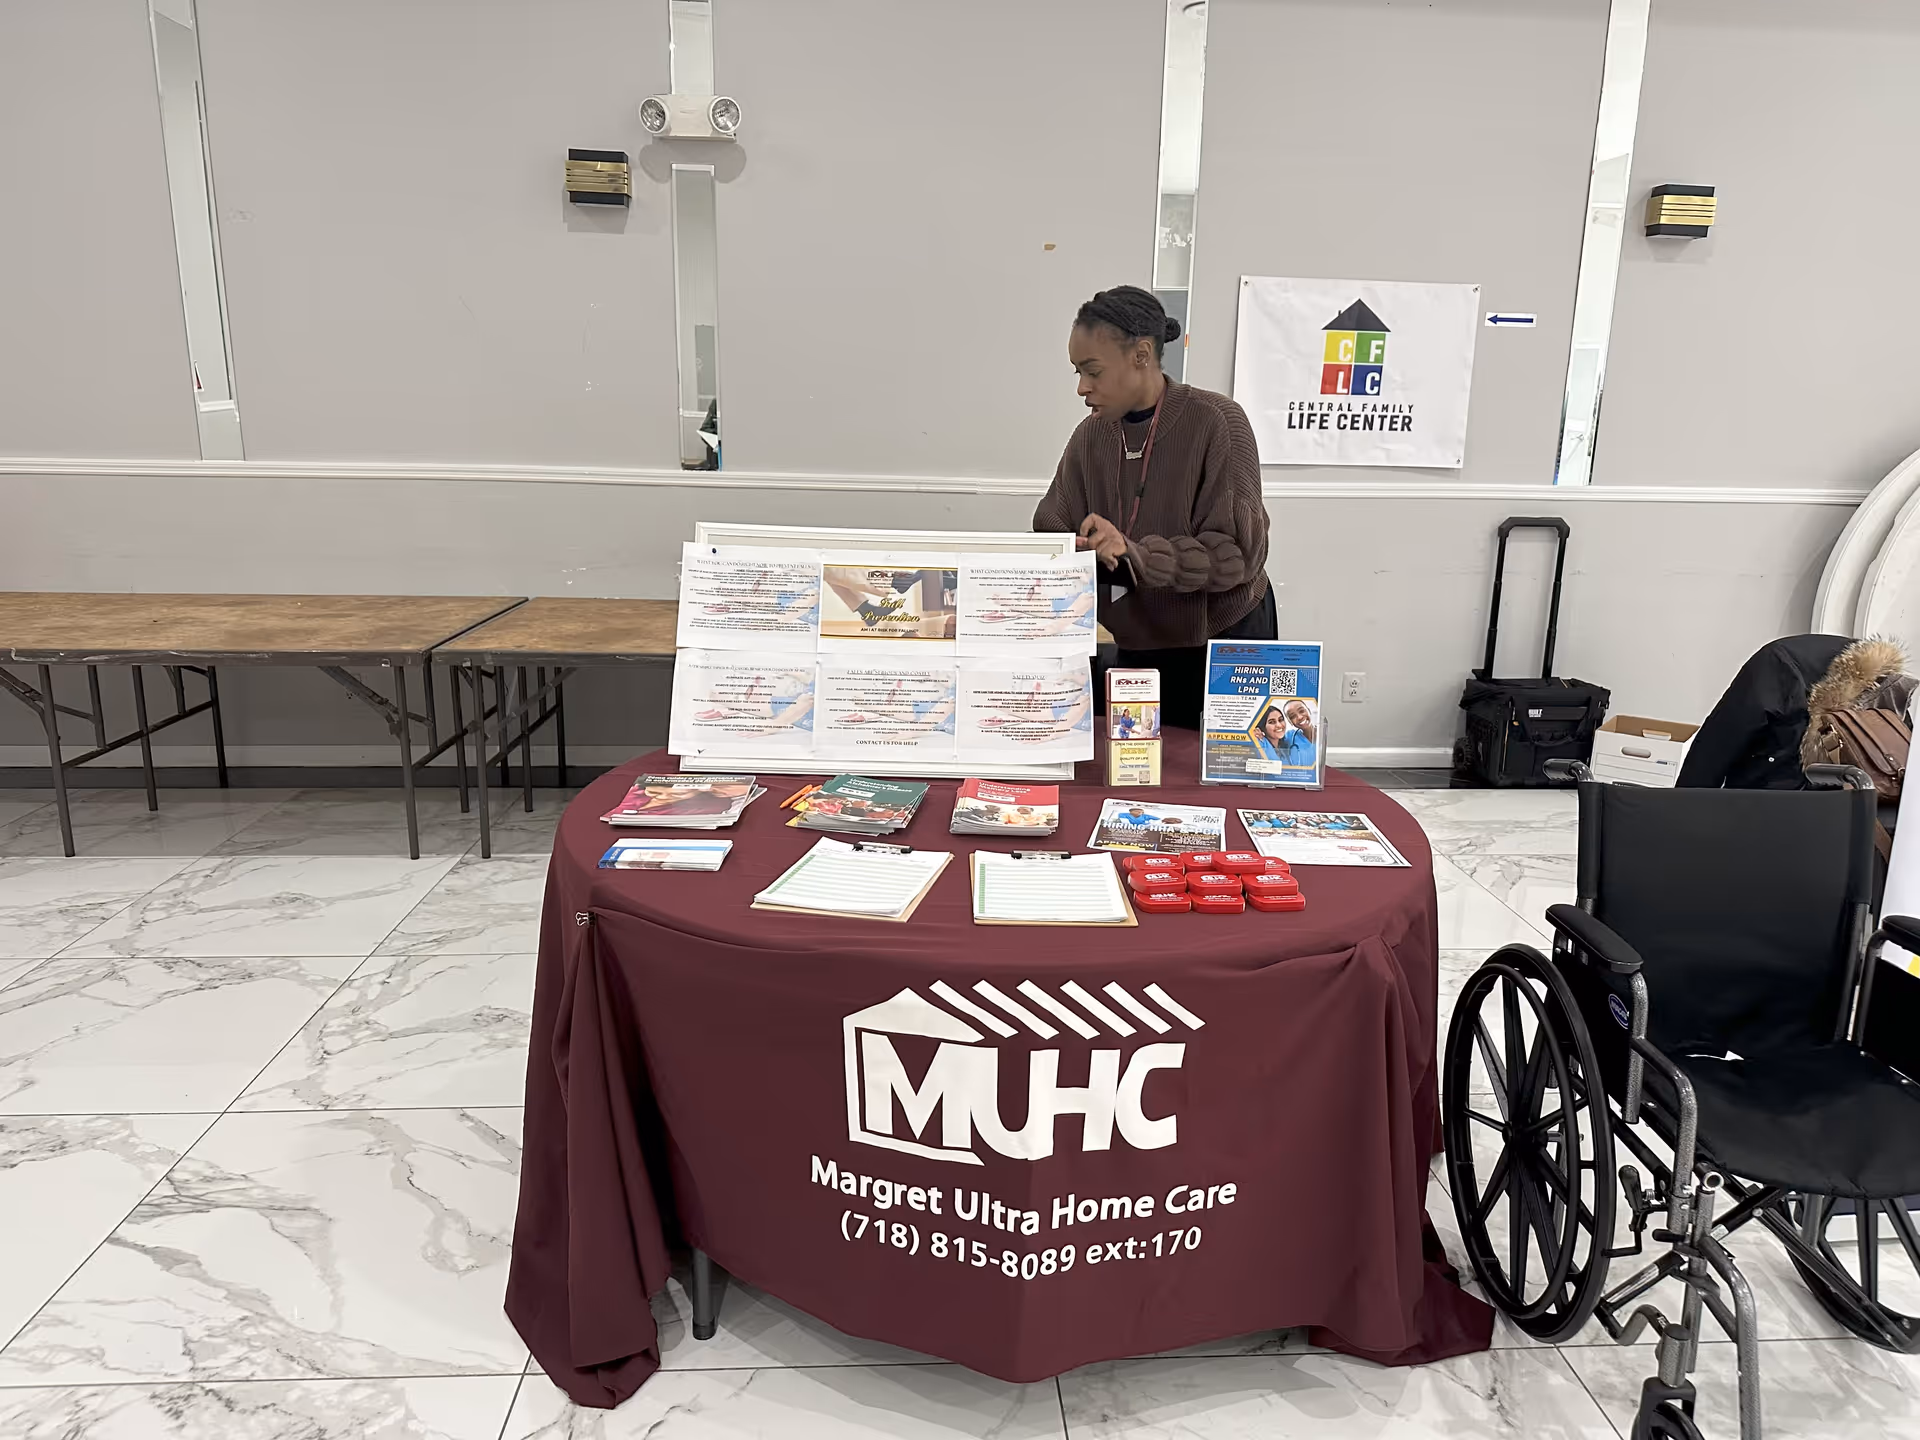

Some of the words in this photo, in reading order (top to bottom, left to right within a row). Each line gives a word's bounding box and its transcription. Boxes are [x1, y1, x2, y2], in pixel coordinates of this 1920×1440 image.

[1338, 339, 1353, 362] C
[1369, 340, 1384, 362] F
[1336, 371, 1348, 394] L
[1365, 372, 1380, 395] C
[1289, 401, 1353, 412] CENTRAL
[1362, 403, 1414, 413] FAMILY
[1287, 412, 1330, 430] LIFE
[1336, 413, 1413, 432] CENTER
[880, 597, 906, 609] Fall
[861, 611, 920, 623] Prevention
[1234, 666, 1265, 674] HIRING
[1230, 676, 1247, 684] RNs
[1249, 676, 1268, 684] AND
[1237, 686, 1260, 694] LPNs
[1103, 821, 1145, 830] HIRING
[1150, 825, 1175, 833] HHA
[1197, 827, 1219, 836] PCA
[860, 1030, 1186, 1161] MUHC
[810, 1154, 943, 1215] Margret
[954, 1187, 1040, 1236] Ultra
[1051, 1194, 1154, 1230] Home
[1165, 1181, 1238, 1216] Care
[840, 1210, 921, 1256] (718)
[930, 1235, 1077, 1281] 815-8089
[1085, 1225, 1203, 1266] ext:170
